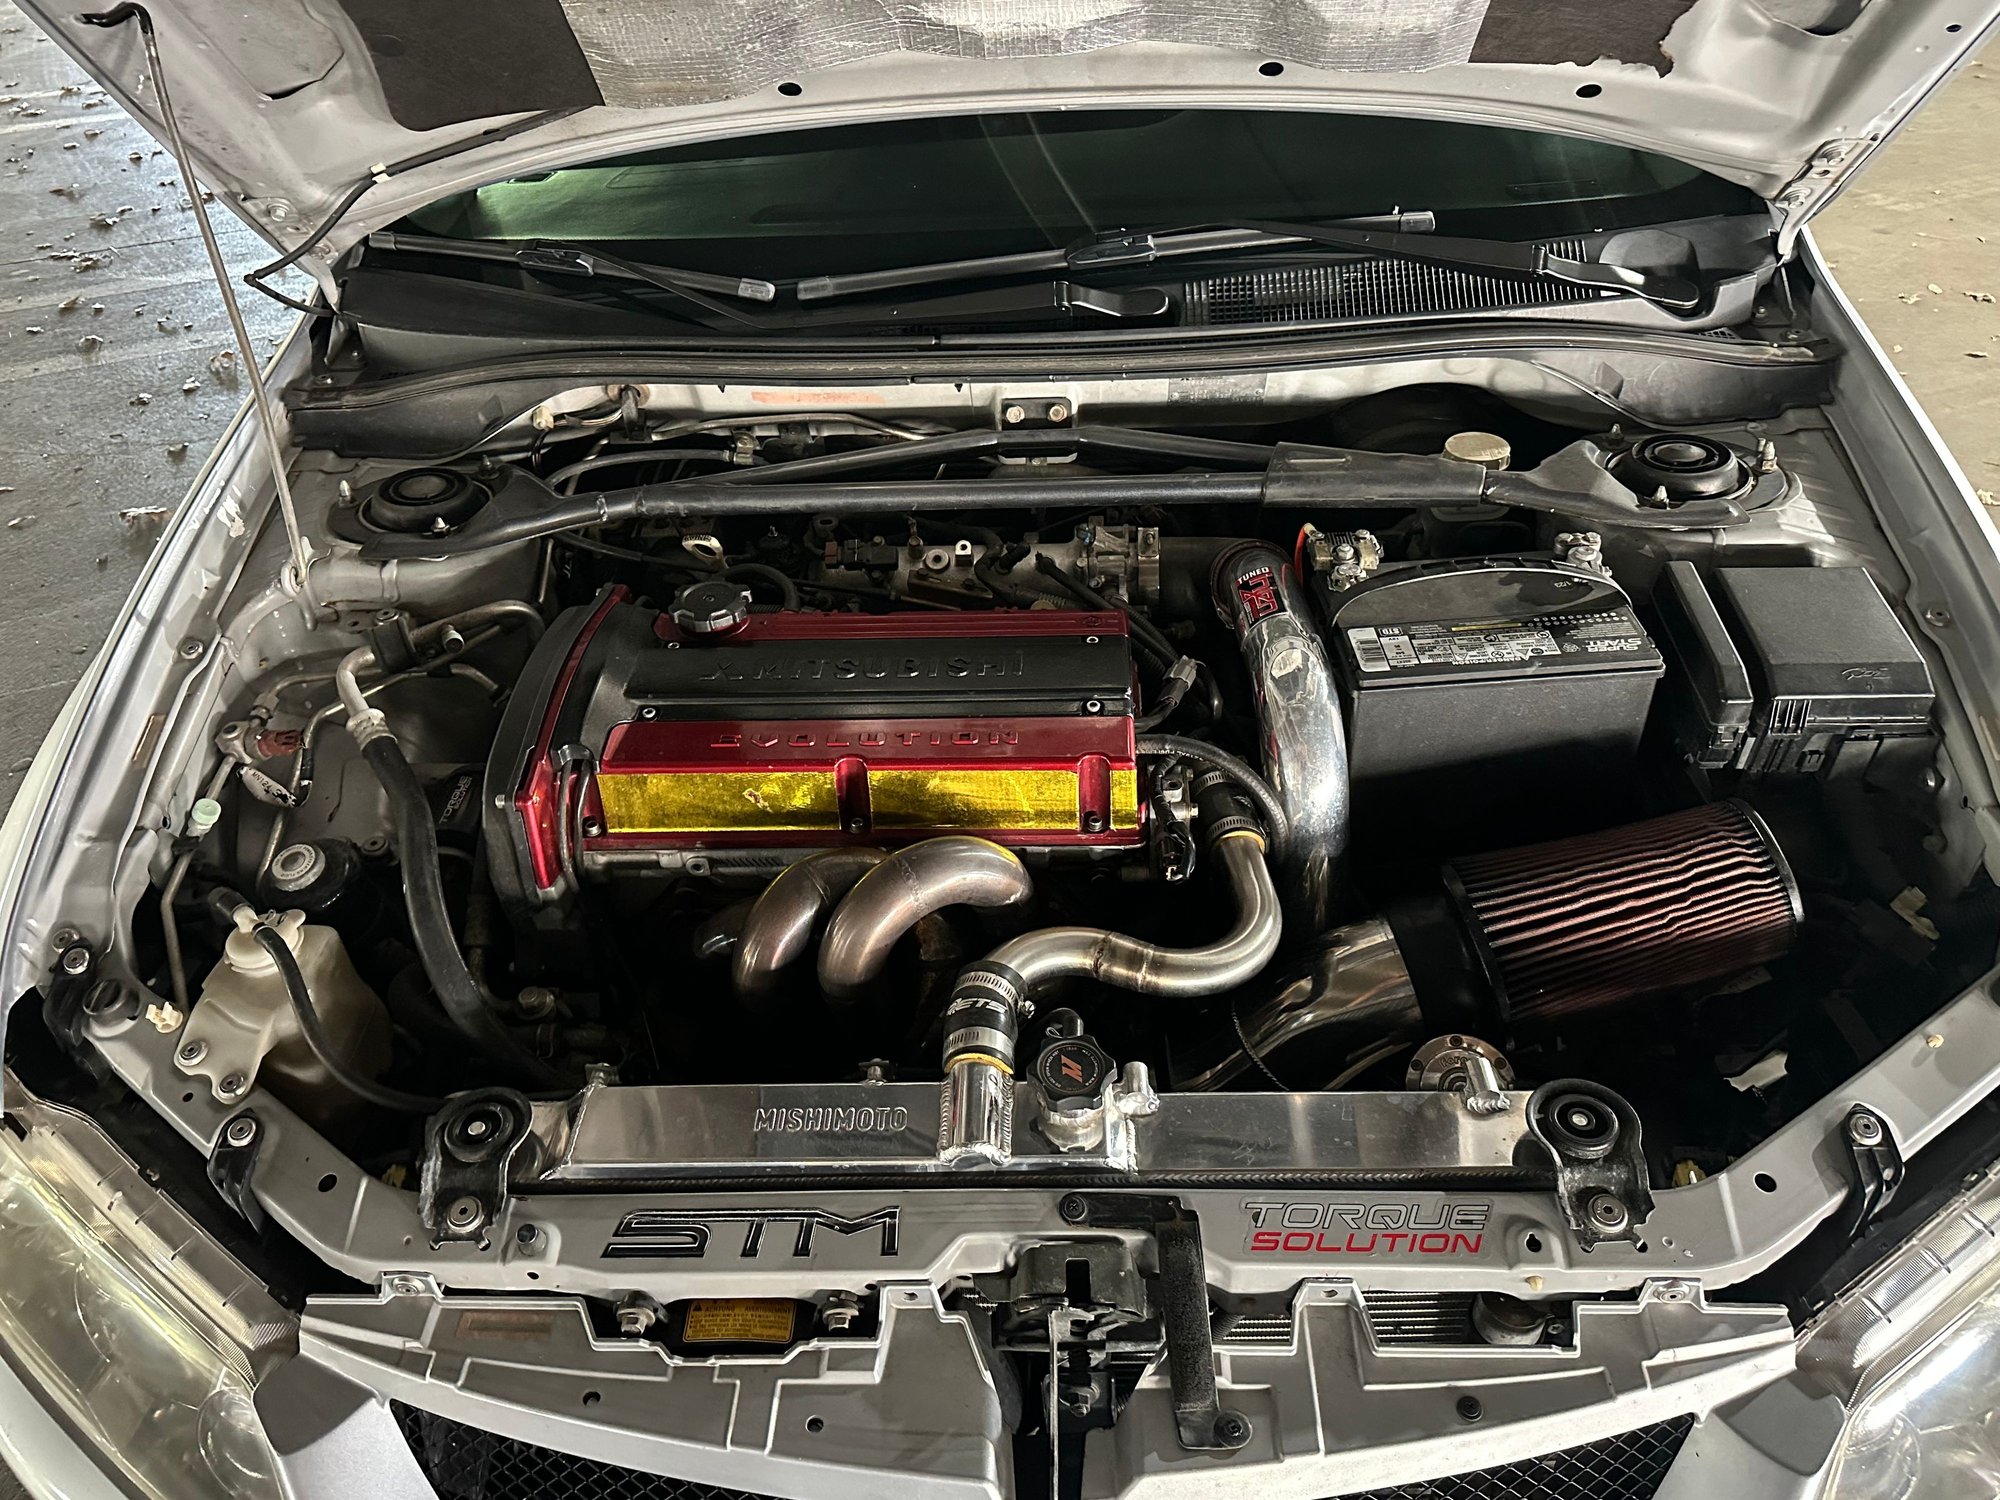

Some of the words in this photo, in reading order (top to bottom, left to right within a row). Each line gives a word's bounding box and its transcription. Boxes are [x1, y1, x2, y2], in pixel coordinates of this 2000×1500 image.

[1238, 567, 1270, 585] TUNED
[1586, 644, 1638, 652] SUPER
[1589, 638, 1641, 647] START
[752, 653, 1024, 680] MITSUBISHI
[711, 730, 1019, 748] EVOLUTION
[439, 776, 465, 824] TORQUE
[753, 1107, 908, 1132] MISHIMOTO
[1245, 1202, 1490, 1230] TORQUE
[600, 1206, 900, 1258] STM
[1250, 1232, 1483, 1253] SOLUTION
